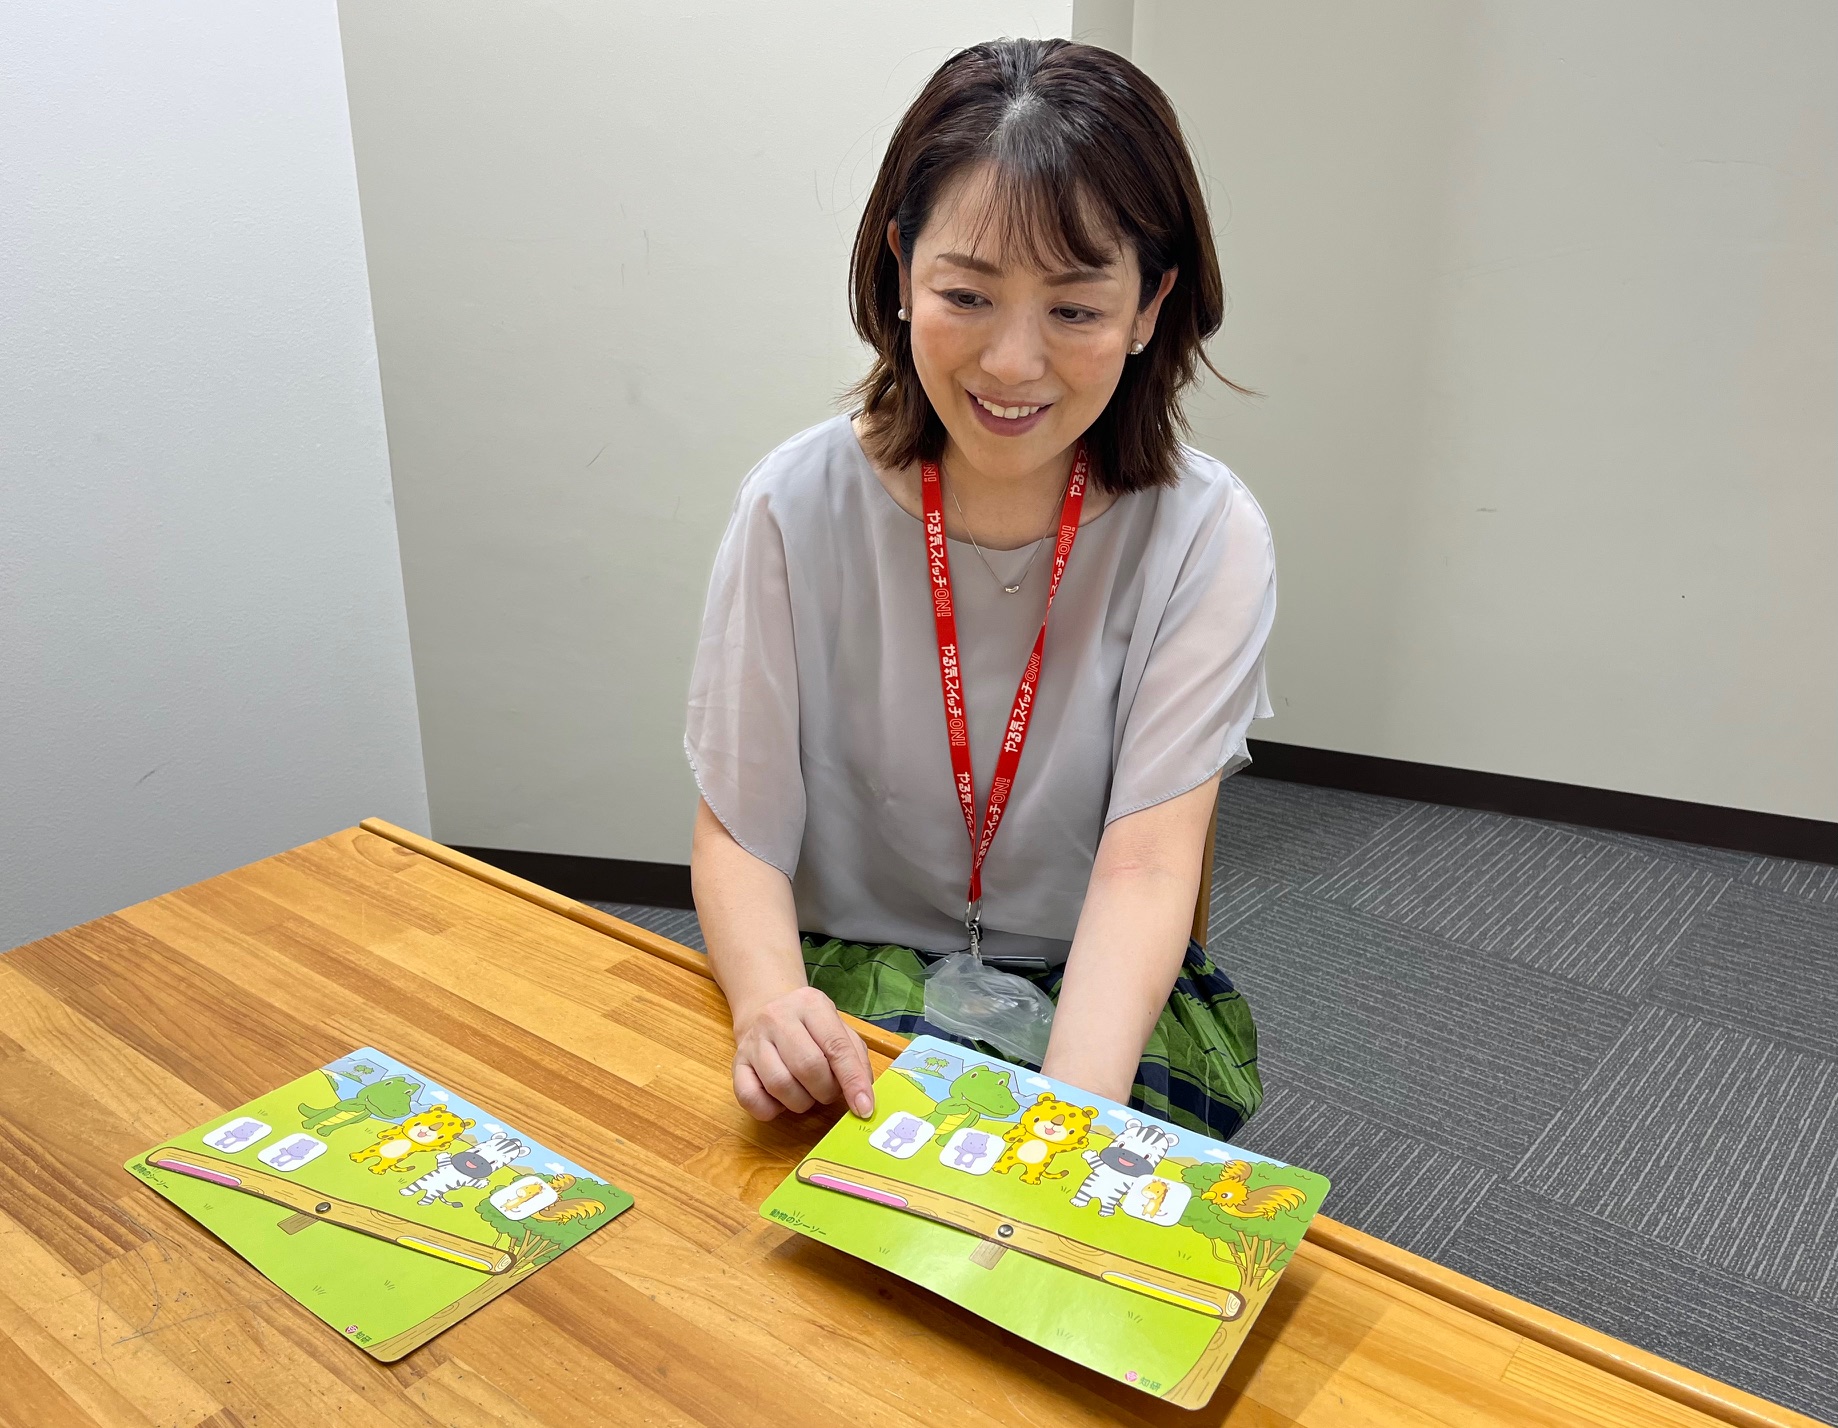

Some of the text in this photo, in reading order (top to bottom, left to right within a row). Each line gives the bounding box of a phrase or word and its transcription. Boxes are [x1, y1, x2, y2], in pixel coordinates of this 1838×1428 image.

[926, 509, 952, 618] やる気スイッチON!
[941, 643, 966, 748] やる気スイッチON!
[1004, 652, 1041, 753] やる気スイッチON!
[769, 1208, 827, 1236] 動物のシーソー
[1139, 1376, 1162, 1392] 知研
